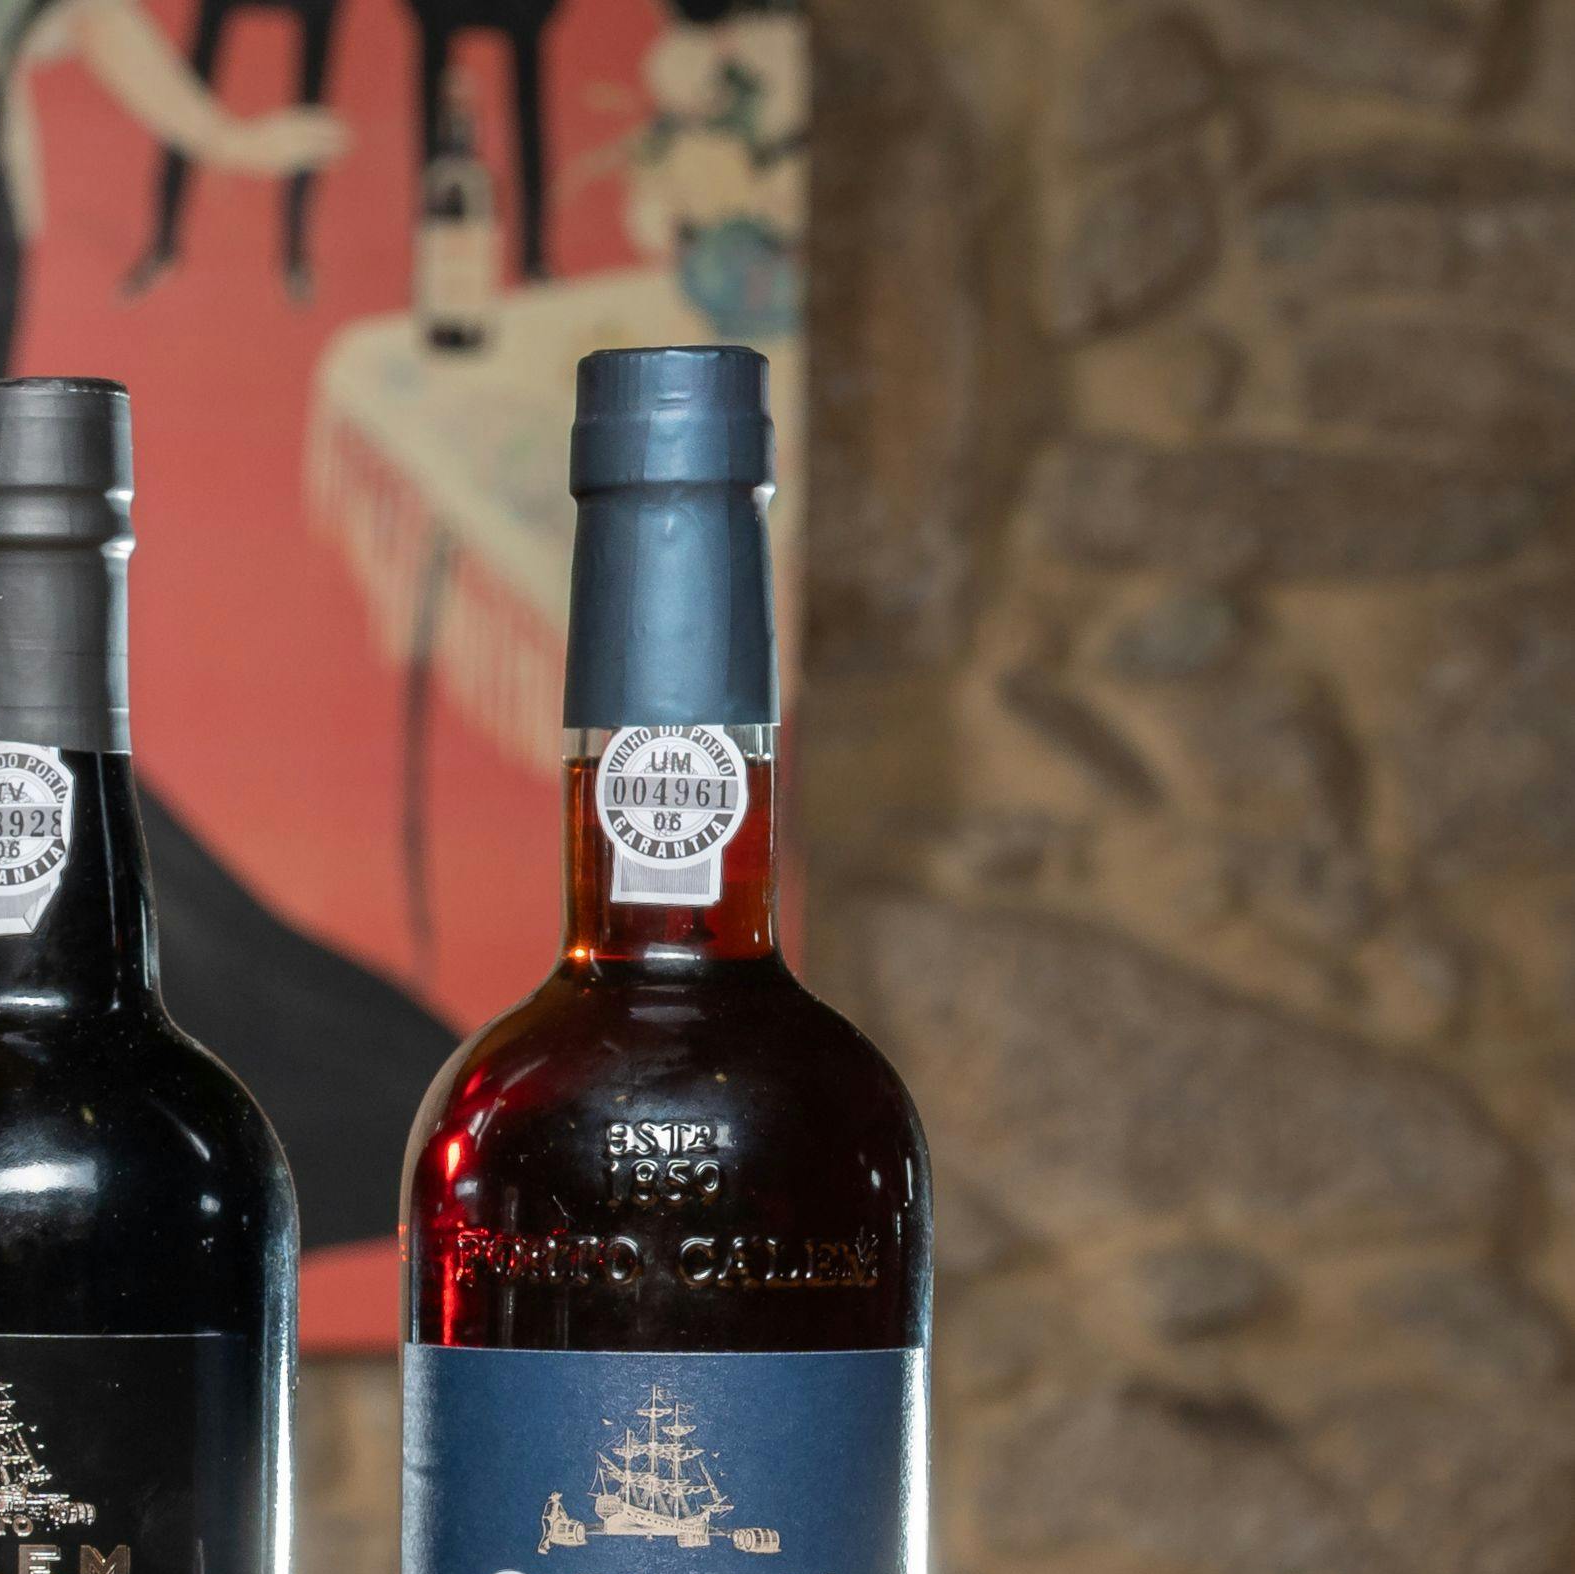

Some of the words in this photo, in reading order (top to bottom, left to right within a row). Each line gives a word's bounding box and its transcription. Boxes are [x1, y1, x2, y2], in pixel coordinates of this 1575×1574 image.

[609, 727, 652, 773] VINHO
[659, 725, 683, 738] DO
[689, 727, 735, 775] PORTO
[651, 751, 692, 774] UM
[25, 757, 67, 803] PORTO
[612, 776, 731, 809] 004961
[612, 818, 726, 858] GARANTIA
[653, 812, 682, 832] 06
